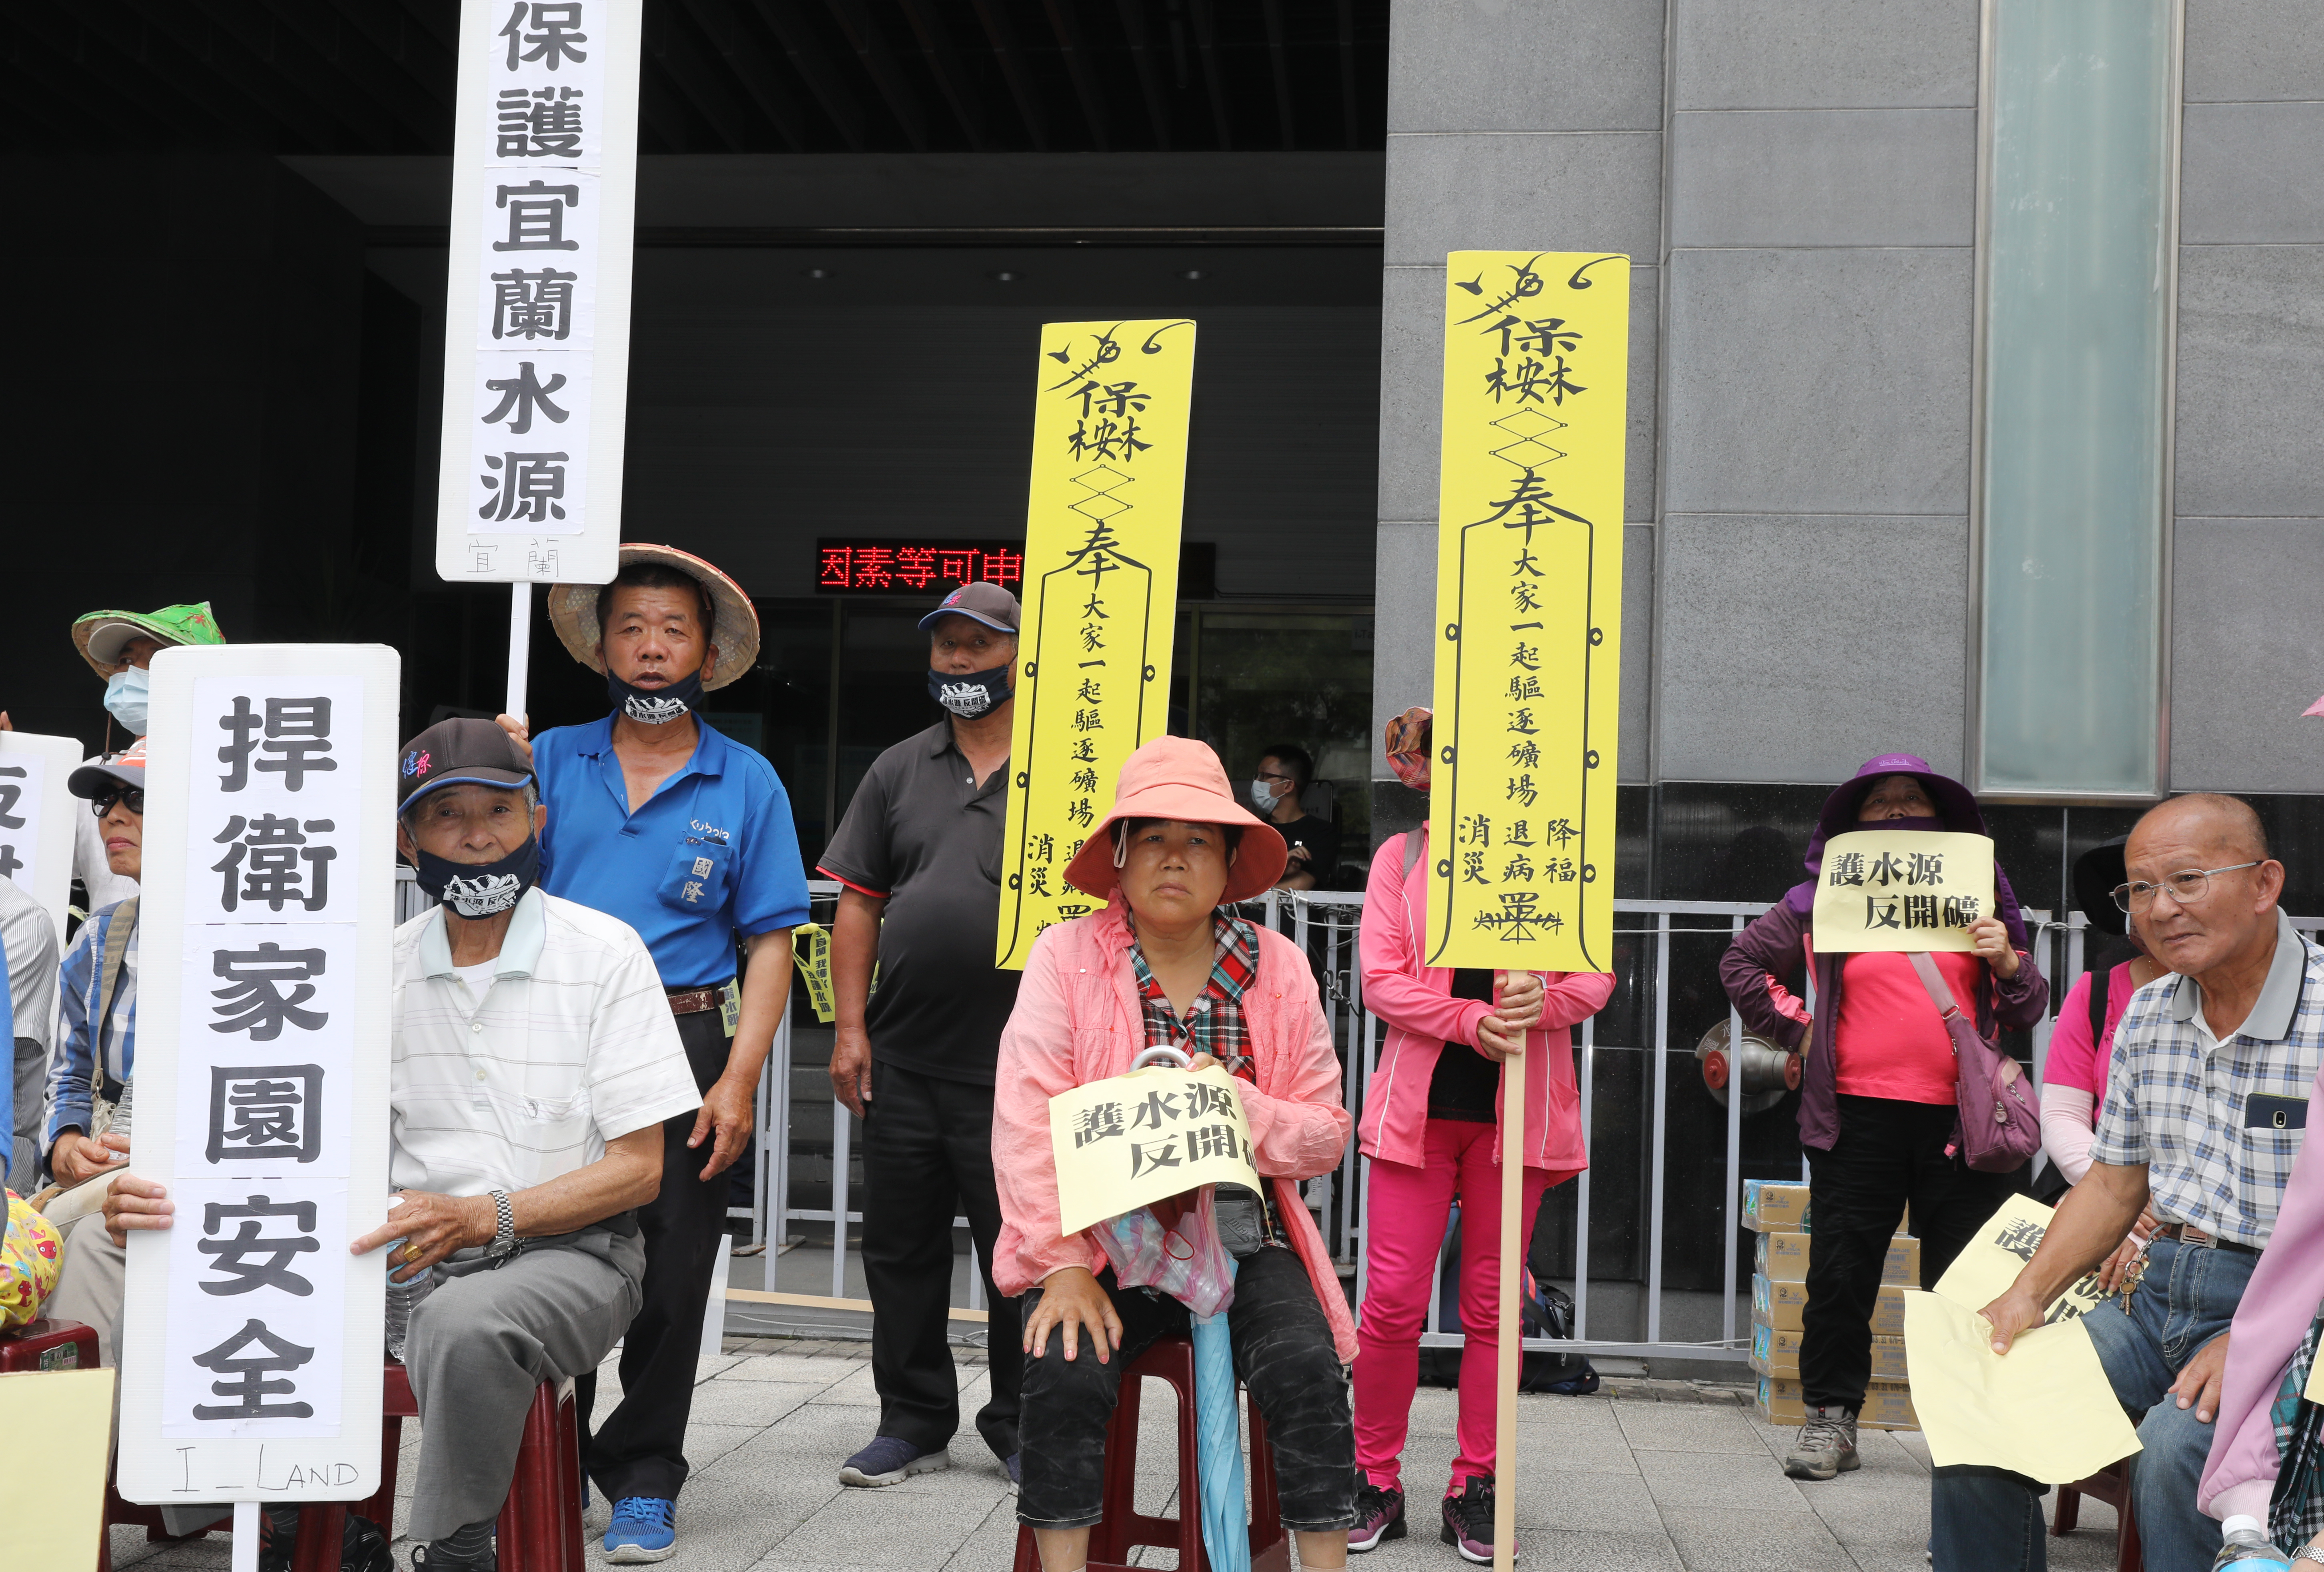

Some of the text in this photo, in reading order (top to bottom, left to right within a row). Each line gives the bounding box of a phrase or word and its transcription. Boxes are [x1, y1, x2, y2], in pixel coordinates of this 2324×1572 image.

[479, 1, 587, 522] 保護宜蘭水源
[1028, 834, 1054, 897] 消災
[1459, 814, 1491, 885] 消災
[1543, 818, 1581, 884] 降福
[1829, 852, 1945, 887] 護水源
[1864, 894, 1979, 930] 反開礦
[192, 696, 338, 1421] 捍衛家園安全
[1072, 1082, 1237, 1149] 護水源
